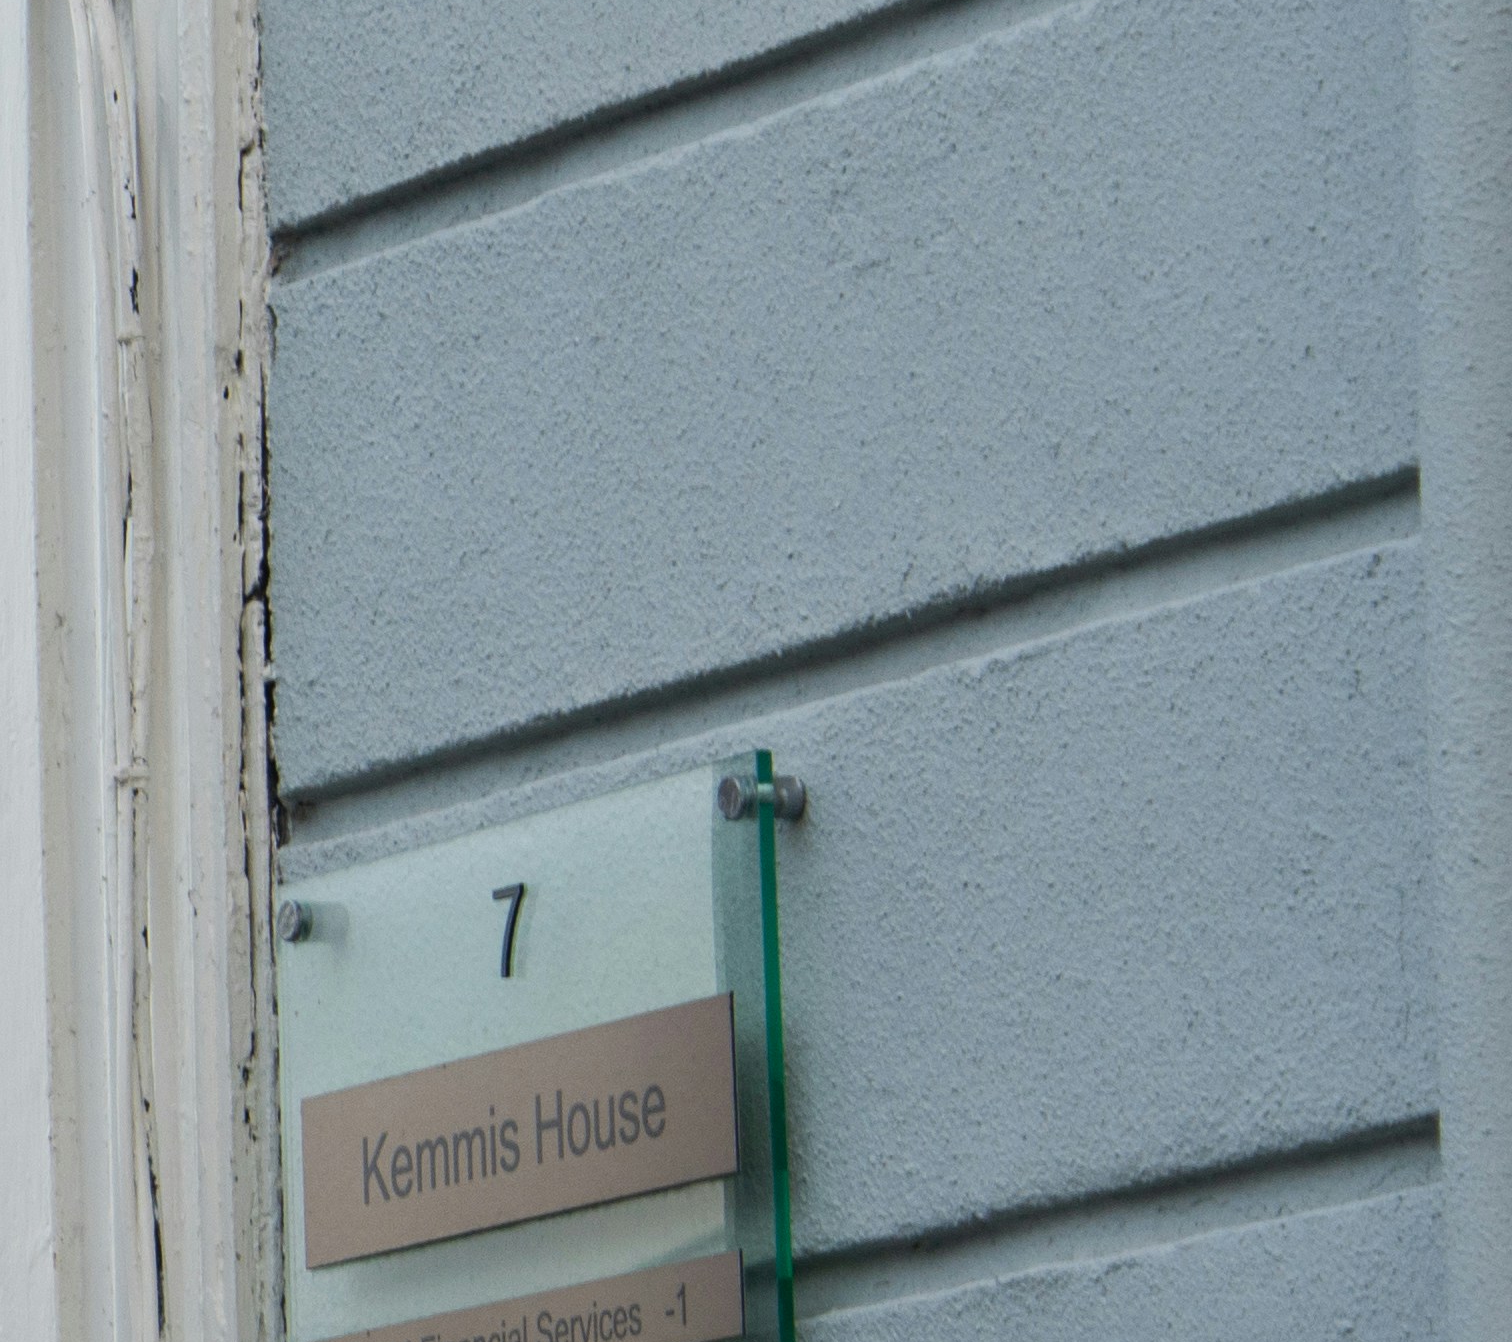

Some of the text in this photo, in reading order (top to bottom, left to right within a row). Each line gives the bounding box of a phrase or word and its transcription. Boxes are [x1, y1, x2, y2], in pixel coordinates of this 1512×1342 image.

[492, 883, 525, 978] 7
[362, 1084, 666, 1205] Kemmis House
